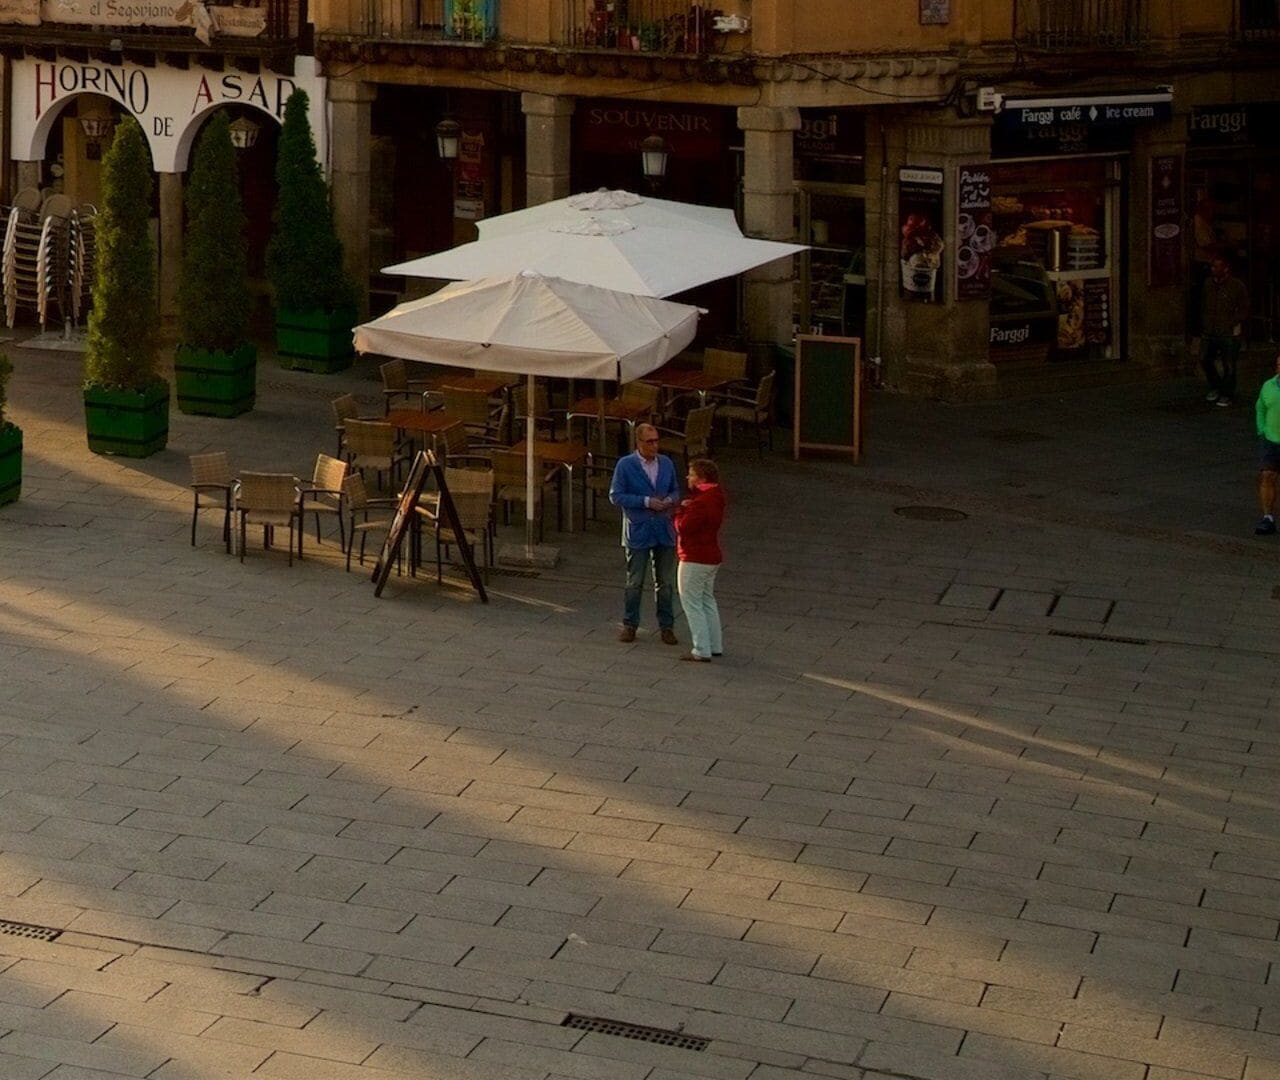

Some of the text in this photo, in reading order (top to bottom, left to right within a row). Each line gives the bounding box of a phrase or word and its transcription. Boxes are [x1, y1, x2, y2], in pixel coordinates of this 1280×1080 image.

[90, 1, 175, 22] el Segoviano
[35, 63, 149, 120] HORNO
[589, 108, 713, 132] SOUVENIR
[1021, 108, 1054, 125] Farggi
[1060, 106, 1081, 121] café
[1123, 106, 1154, 118] cream
[1190, 106, 1248, 133] Farggi
[153, 116, 174, 137] DE
[989, 324, 1031, 344] Farggi
